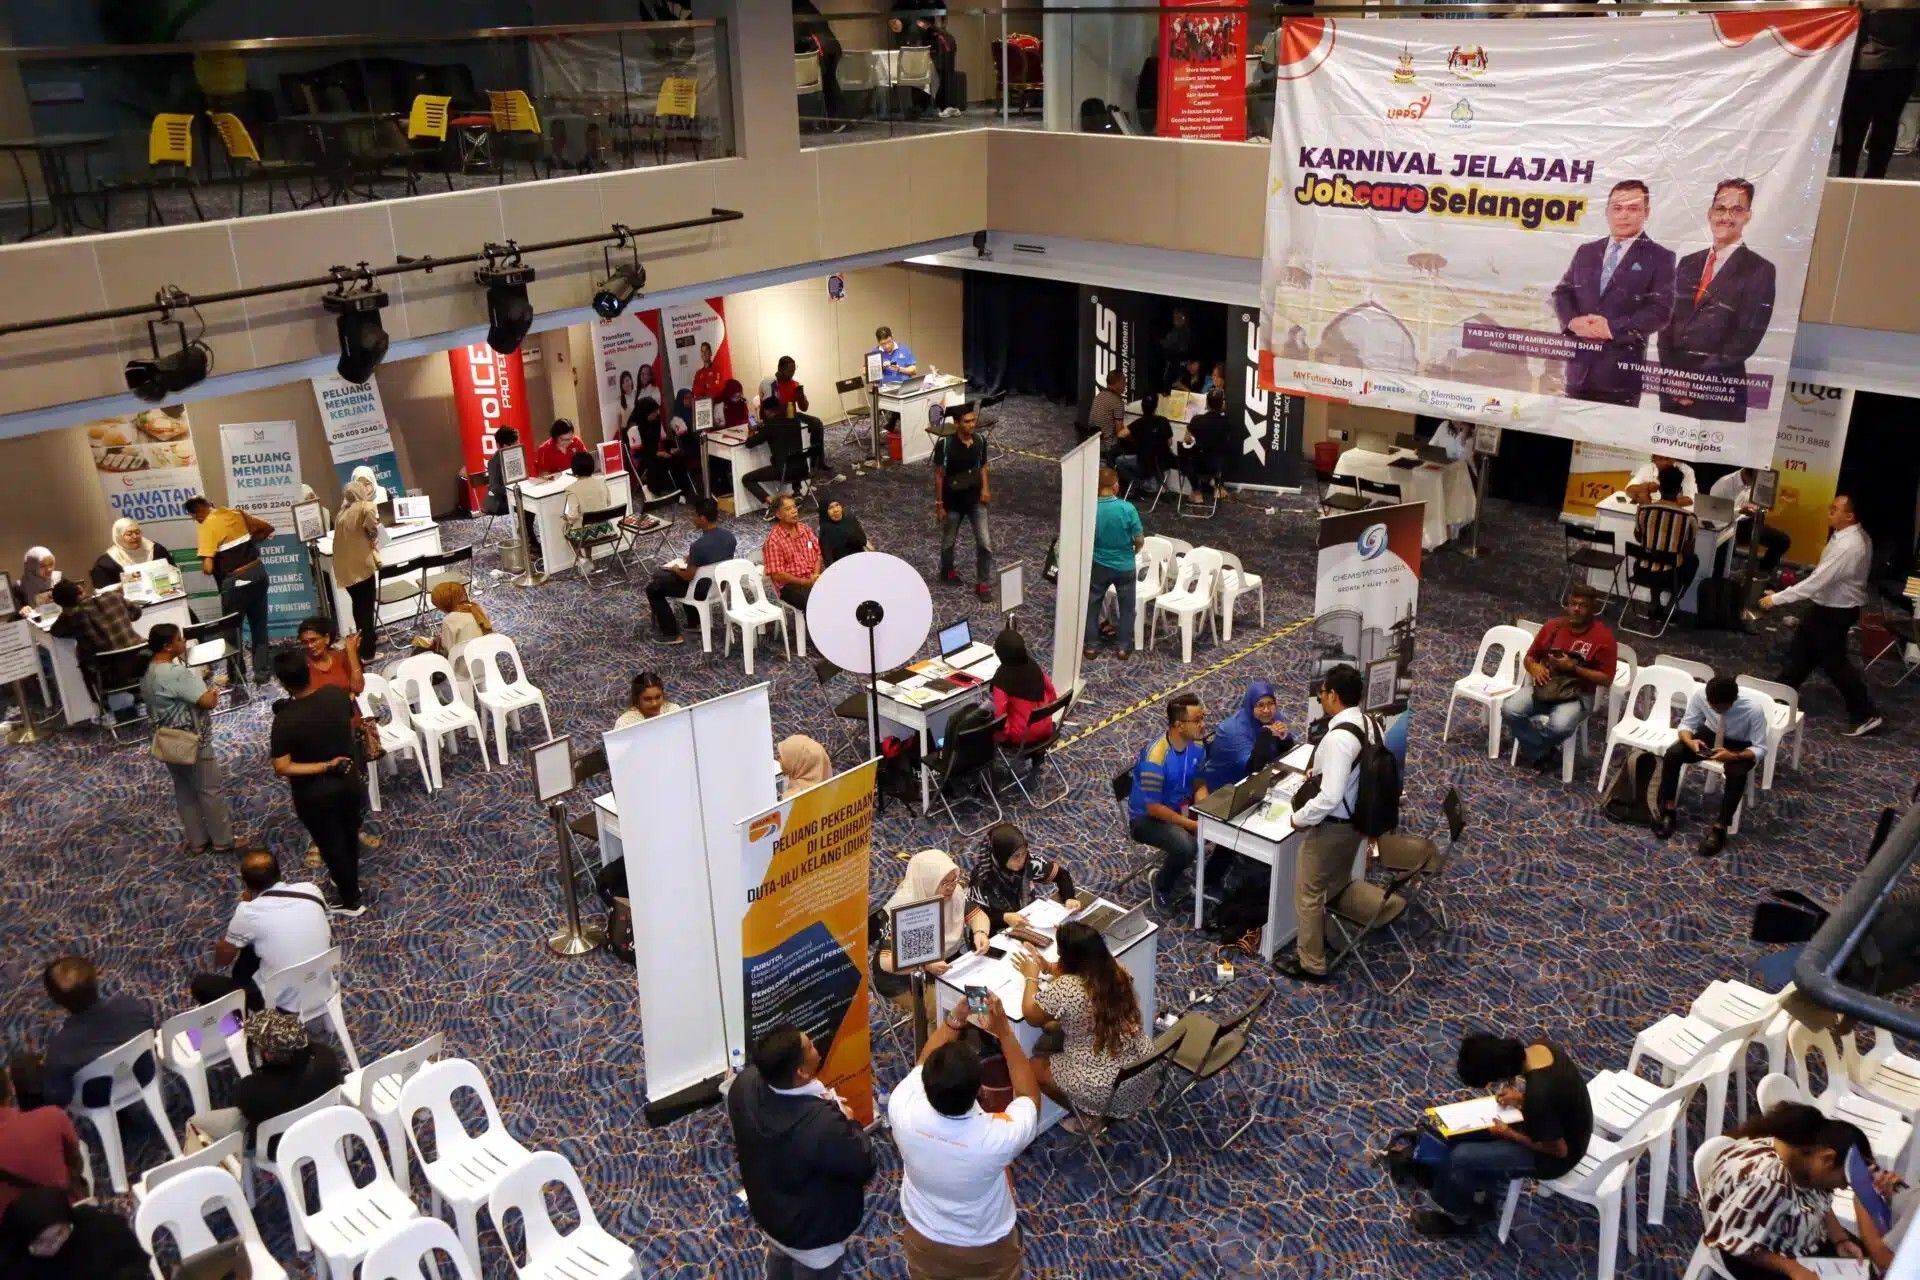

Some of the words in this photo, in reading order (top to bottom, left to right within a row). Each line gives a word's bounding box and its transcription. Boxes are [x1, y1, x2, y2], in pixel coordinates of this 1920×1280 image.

[1387, 108, 1417, 120] UPPS
[1298, 146, 1443, 176] KARNIVAL
[1450, 154, 1595, 184] JELAJAH
[1467, 329, 1483, 337] YAB
[1508, 333, 1524, 341] SERI
[1524, 335, 1564, 347] AMIRUDIN
[1564, 339, 1577, 348] BIN
[1578, 341, 1603, 352] SHARI
[1095, 302, 1117, 397] ES
[1490, 341, 1518, 350] MENTERI
[1518, 344, 1539, 353] BESAR
[1540, 347, 1576, 358] SELANGOR
[1293, 370, 1352, 388] MYFutureJobs
[1617, 362, 1629, 370] YB
[1630, 363, 1652, 373] TUAN
[1652, 365, 1704, 382] PAPPARAIDU
[1722, 376, 1770, 389] VERAMAN
[1642, 375, 1661, 384] EXCO
[1662, 377, 1691, 388] SUMBER
[1692, 382, 1728, 393] MANUSIA
[322, 382, 372, 400] PELUANG
[1374, 384, 1406, 394] PERKESO
[1430, 390, 1473, 403] Membawa
[1642, 384, 1688, 397] PEMBASMIAN
[1688, 391, 1736, 403] KEMISKINAN
[324, 392, 375, 410] MEMBINA
[1272, 392, 1282, 406] Eve
[330, 403, 376, 420] KERJAYA
[1272, 408, 1281, 422] For
[332, 431, 344, 440] 016
[346, 428, 360, 437] 609
[360, 425, 378, 434] 2240
[1272, 423, 1280, 451] Shoes
[1651, 435, 1722, 453] @myfuturejobs
[232, 452, 292, 465] PELUANG
[232, 463, 294, 477] MEMBINA
[236, 476, 292, 488] KERJAYA
[110, 487, 197, 508] JAWATAN
[252, 502, 268, 510] 609
[270, 500, 292, 508] 2240
[260, 546, 286, 555] EVENT
[262, 554, 300, 564] NAGEMENT
[268, 573, 304, 584] TENANCE
[1332, 564, 1407, 583] CHEMSTATIONASIA
[267, 583, 305, 594] NOVATION
[1338, 585, 1360, 593] GROWTH
[275, 602, 311, 612] PRINTING
[772, 820, 818, 856] PELUANG
[820, 792, 873, 830] PEKERJAAN
[806, 840, 818, 855] DI
[747, 866, 799, 904] DUTA-ULU
[800, 848, 842, 876] KELANG
[751, 953, 783, 972] JURUTOL
[751, 976, 788, 998] PENOLONG
